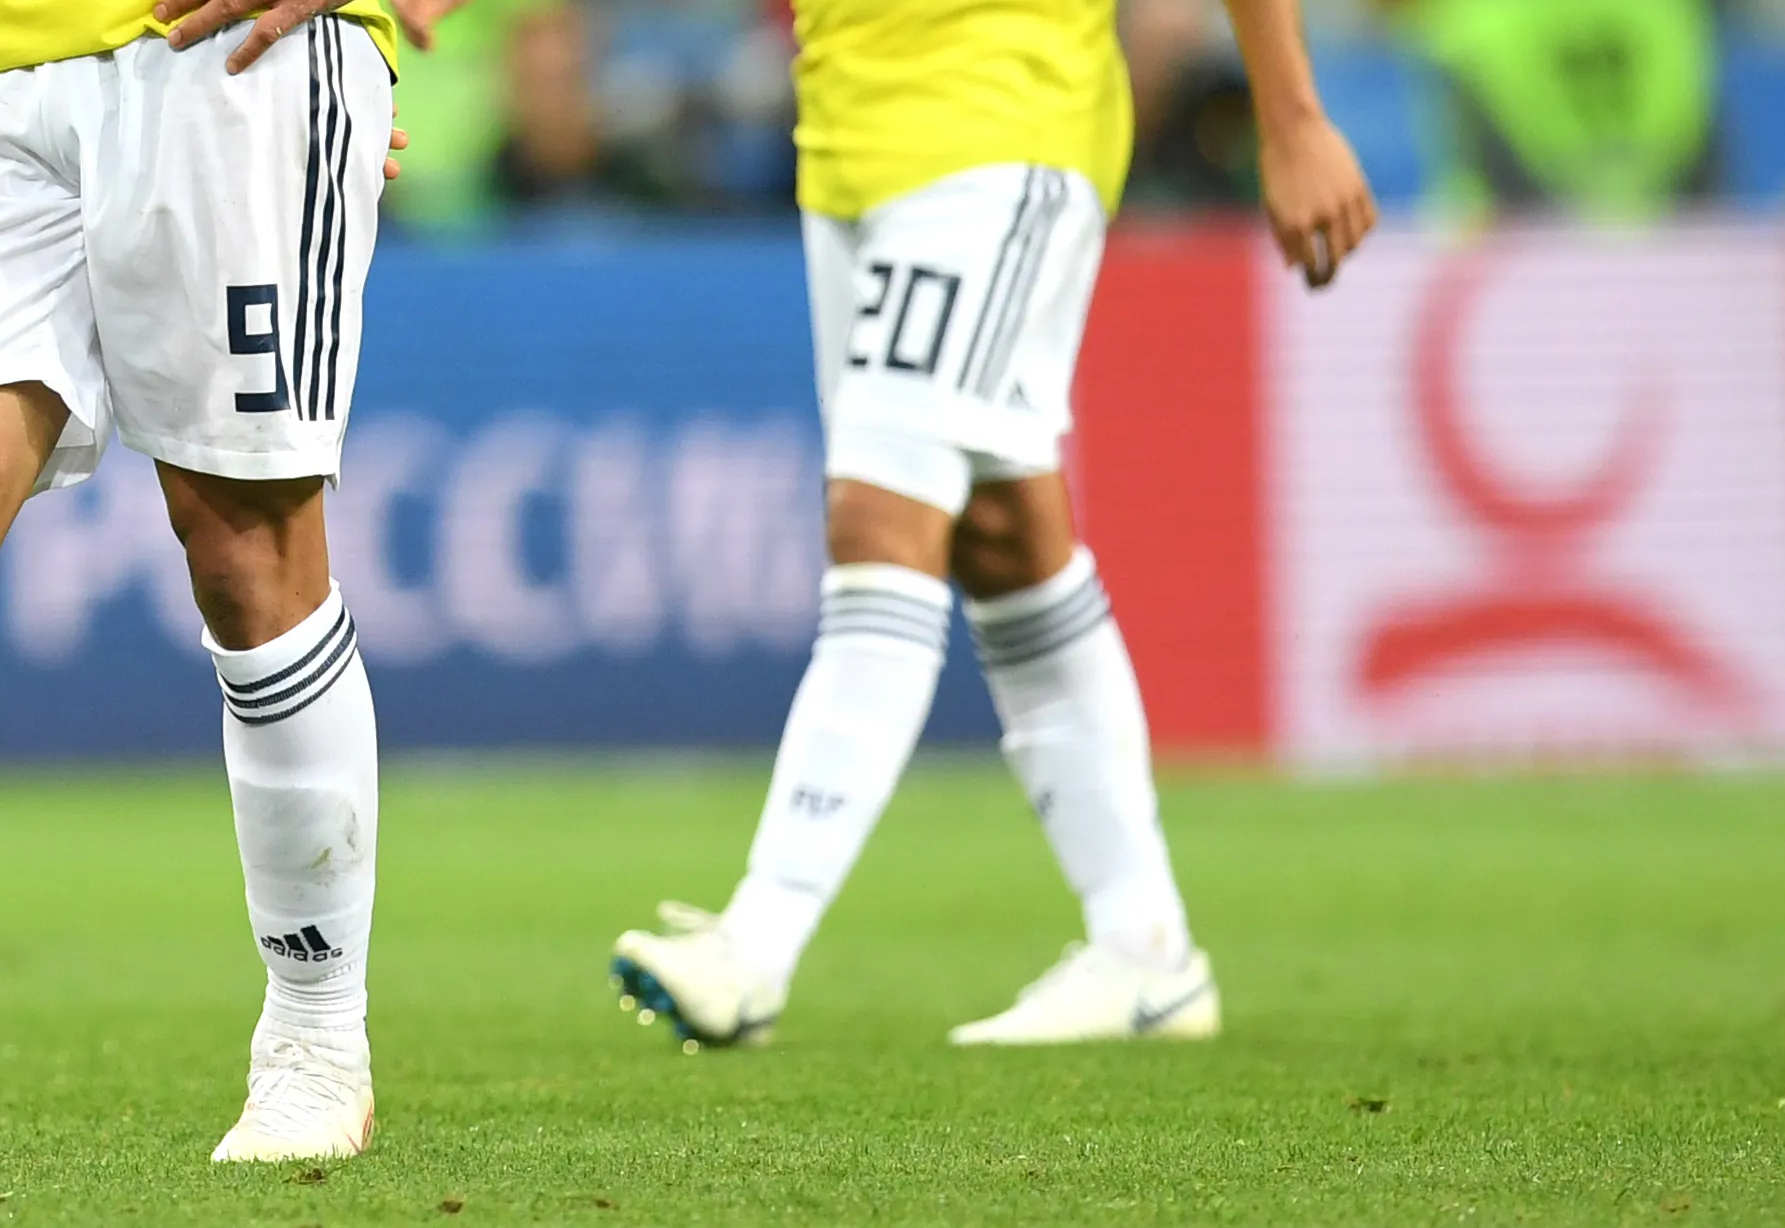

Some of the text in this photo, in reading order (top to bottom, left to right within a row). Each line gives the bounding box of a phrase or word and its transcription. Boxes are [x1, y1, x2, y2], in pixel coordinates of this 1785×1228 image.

[226, 283, 291, 413] 9
[850, 263, 961, 374] 20
[260, 937, 343, 962] adidas
